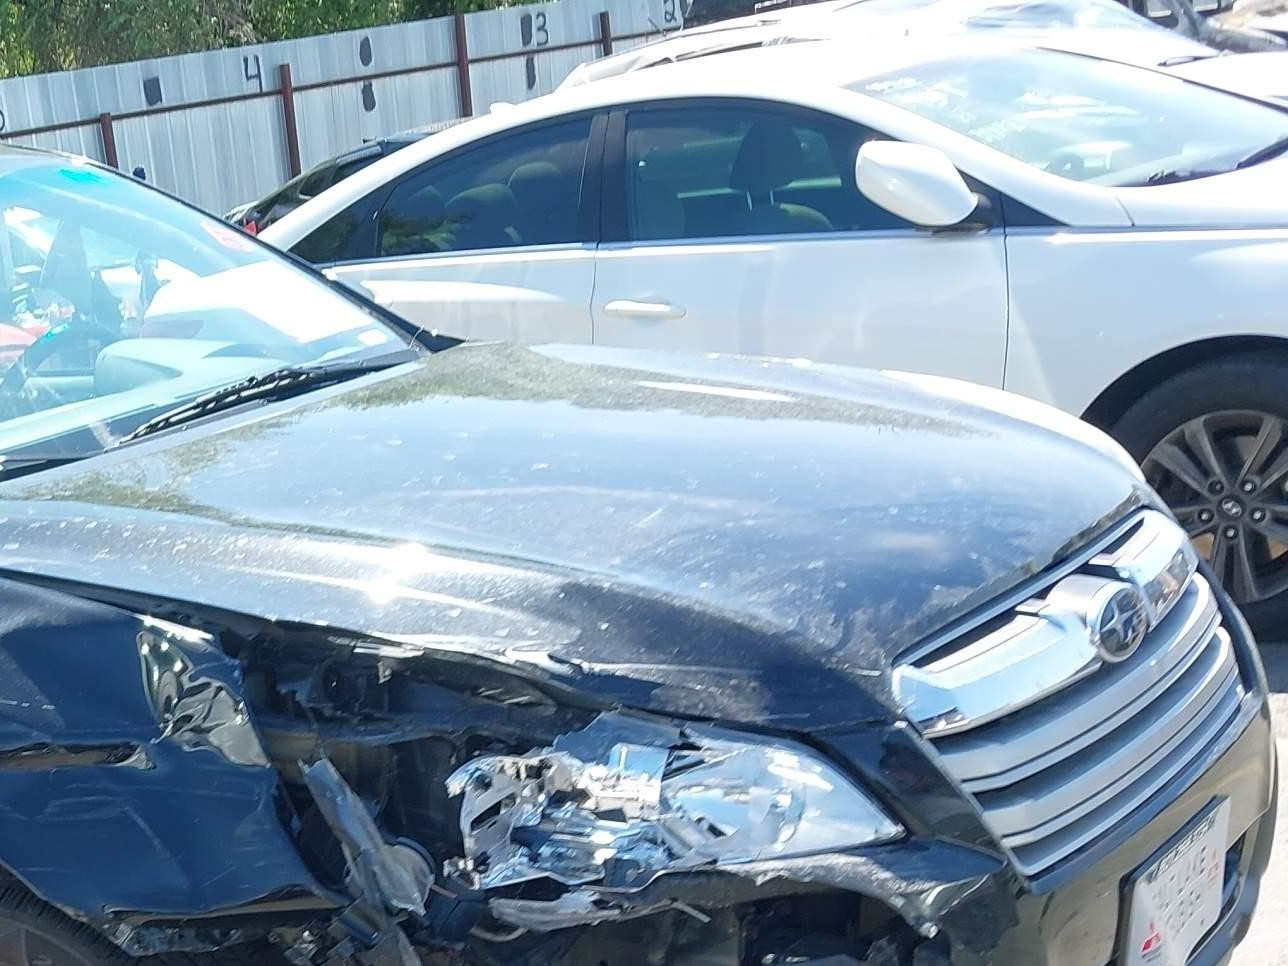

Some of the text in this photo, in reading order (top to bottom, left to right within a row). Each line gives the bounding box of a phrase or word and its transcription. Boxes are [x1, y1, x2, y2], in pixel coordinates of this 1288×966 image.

[535, 11, 549, 47] 3
[663, 0, 678, 23] 2
[242, 54, 263, 92] 4
